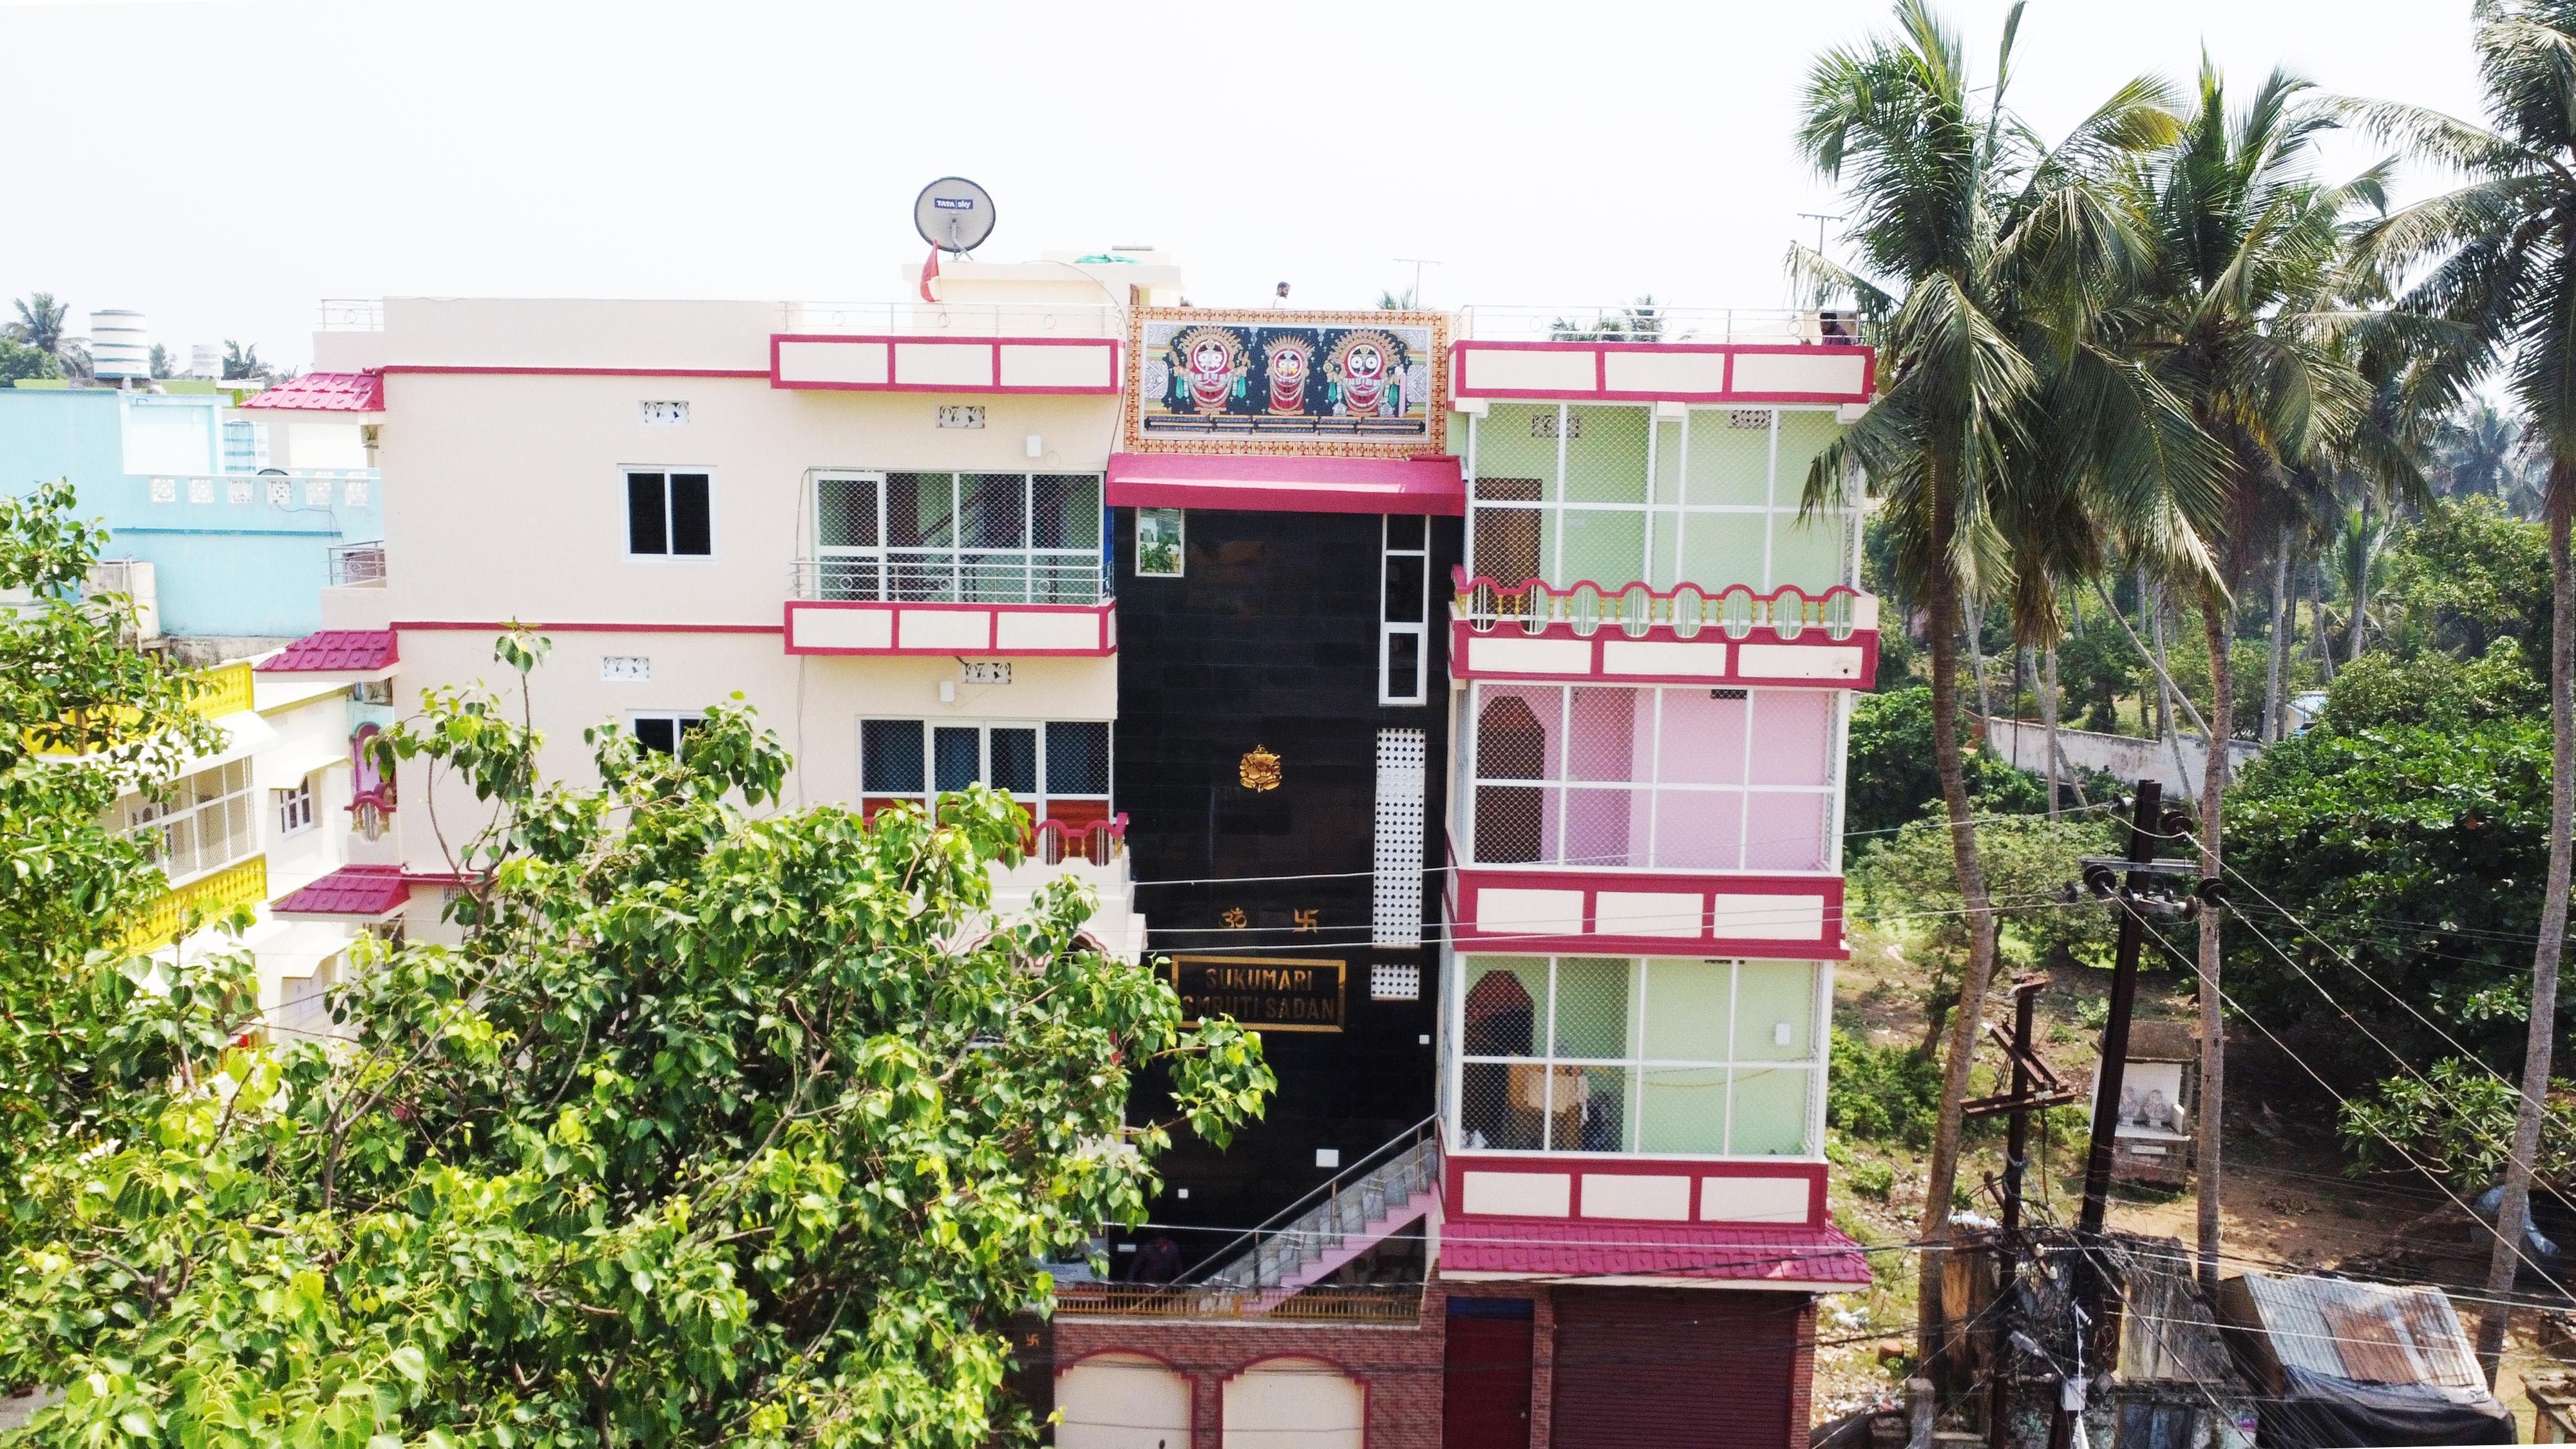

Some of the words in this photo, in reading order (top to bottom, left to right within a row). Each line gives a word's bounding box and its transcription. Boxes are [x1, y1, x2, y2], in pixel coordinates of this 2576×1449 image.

[1206, 968, 1312, 990] SUKUMARI
[1182, 995, 1259, 1018] SMRUTI
[1265, 997, 1334, 1021] SADAN
